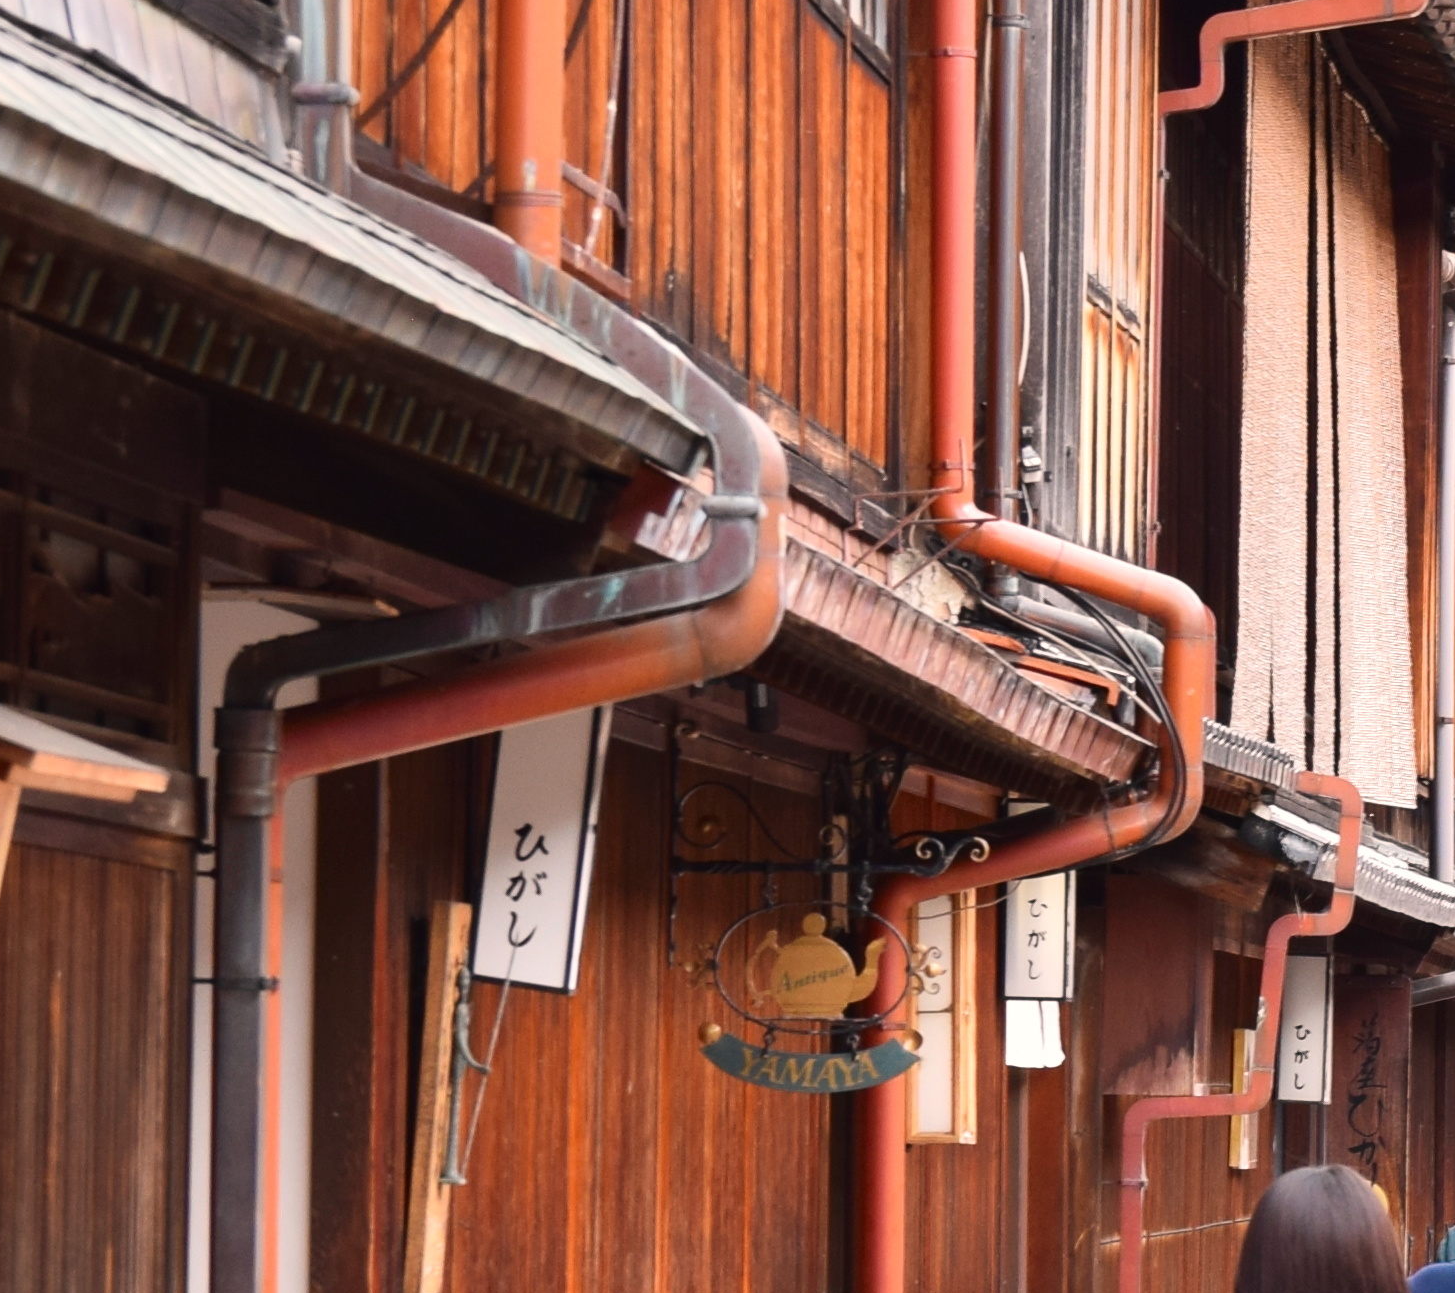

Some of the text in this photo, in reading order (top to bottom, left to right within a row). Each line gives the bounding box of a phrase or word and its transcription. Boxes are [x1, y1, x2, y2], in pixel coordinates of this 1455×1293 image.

[505, 822, 549, 948] ひがし
[1027, 898, 1048, 980] ひがし
[740, 1047, 880, 1089] YAMAYA
[1294, 1024, 1311, 1090] ひがし
